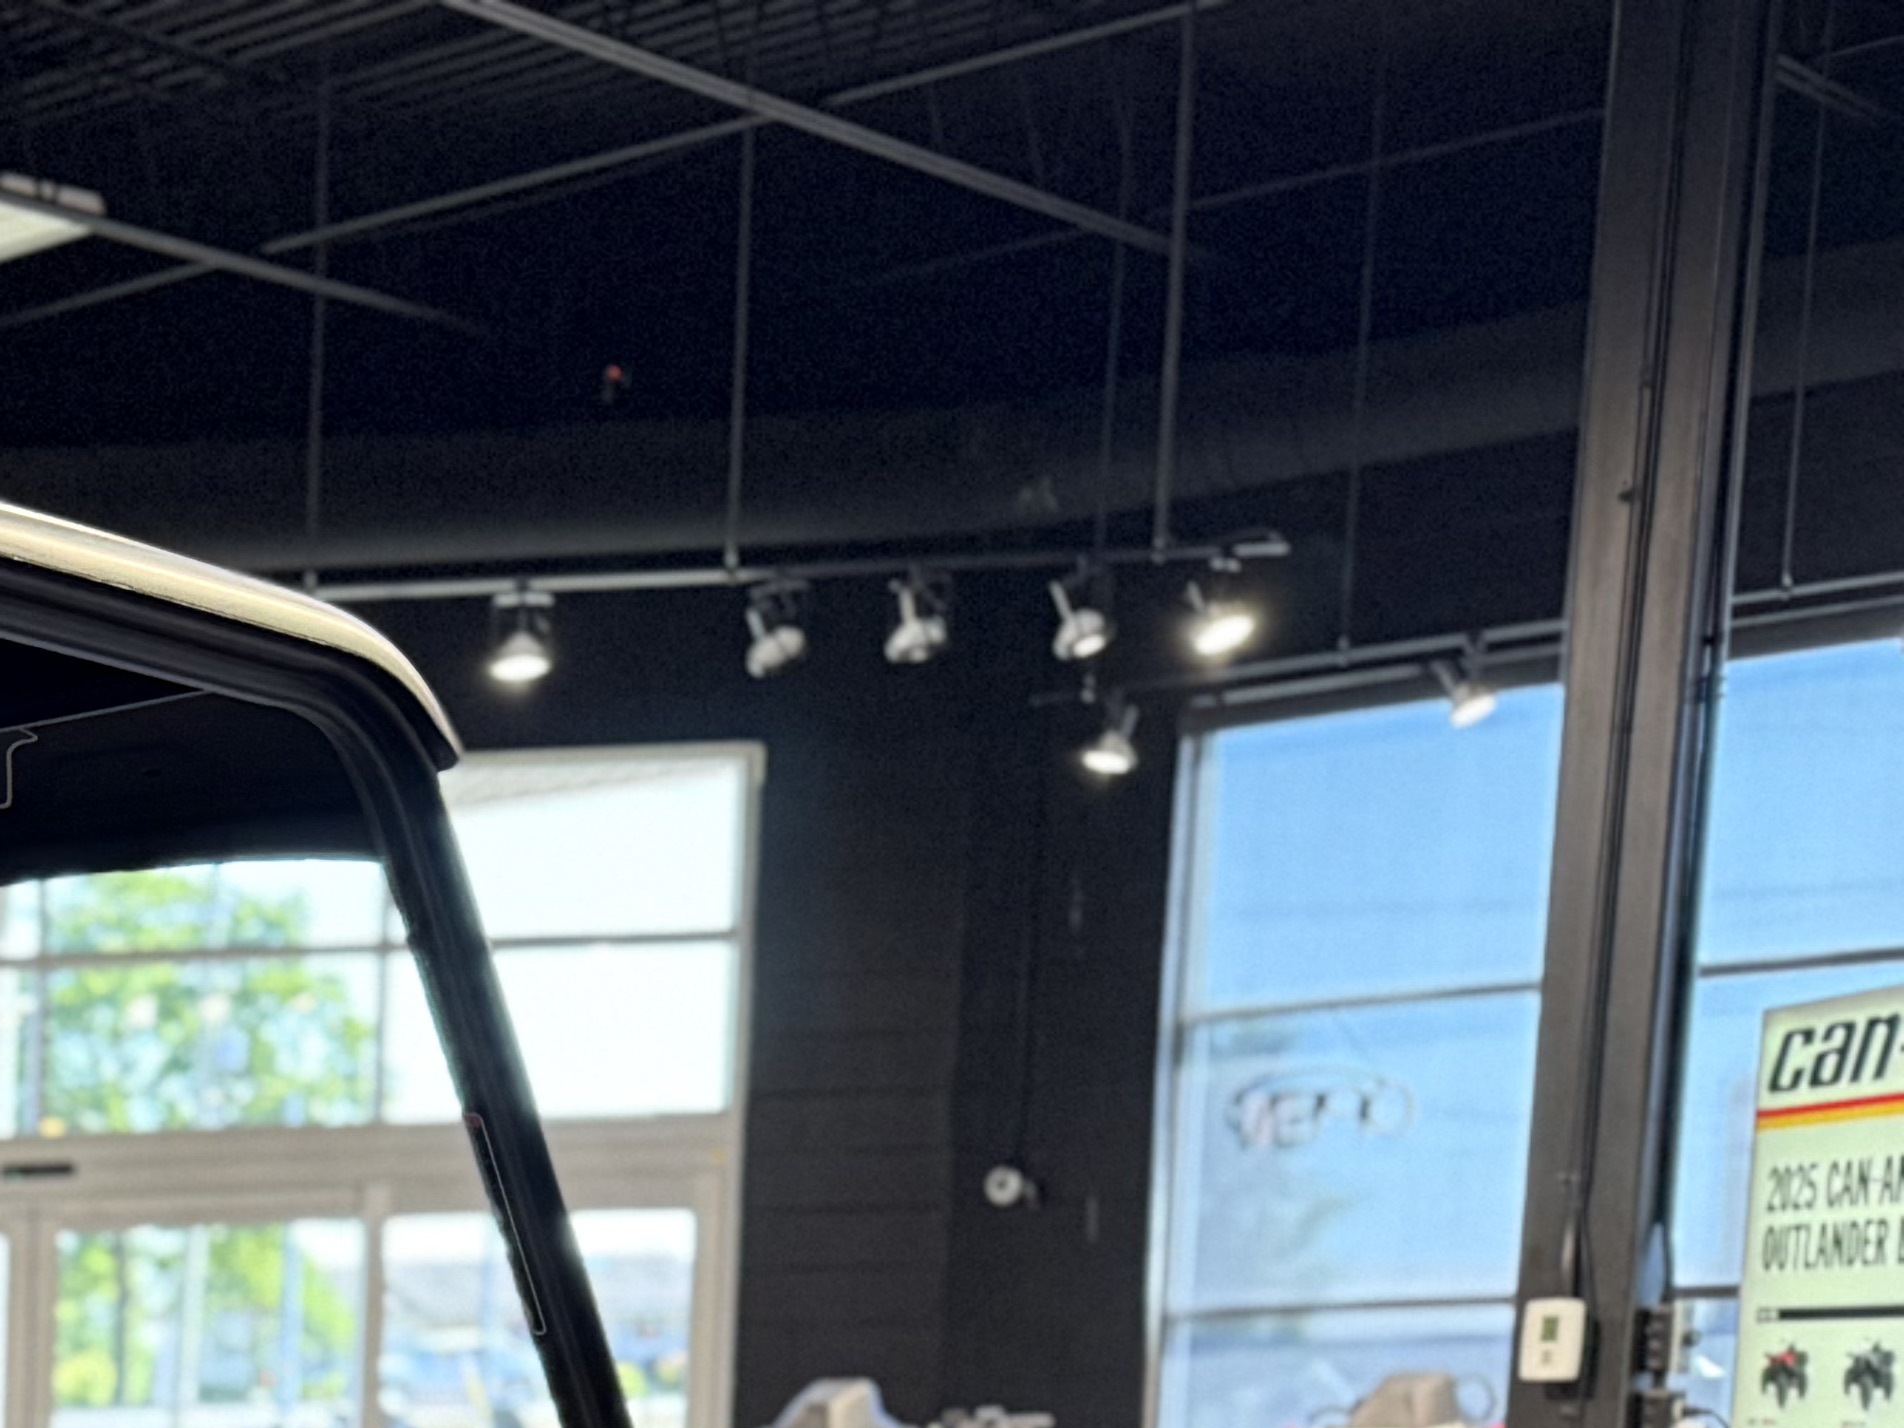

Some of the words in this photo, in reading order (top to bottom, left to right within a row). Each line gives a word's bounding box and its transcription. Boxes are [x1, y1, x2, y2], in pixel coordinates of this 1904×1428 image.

[1768, 1012, 1904, 1094] can
[1766, 1163, 1818, 1213] 2025
[1762, 1217, 1890, 1272] OUTLANDER
